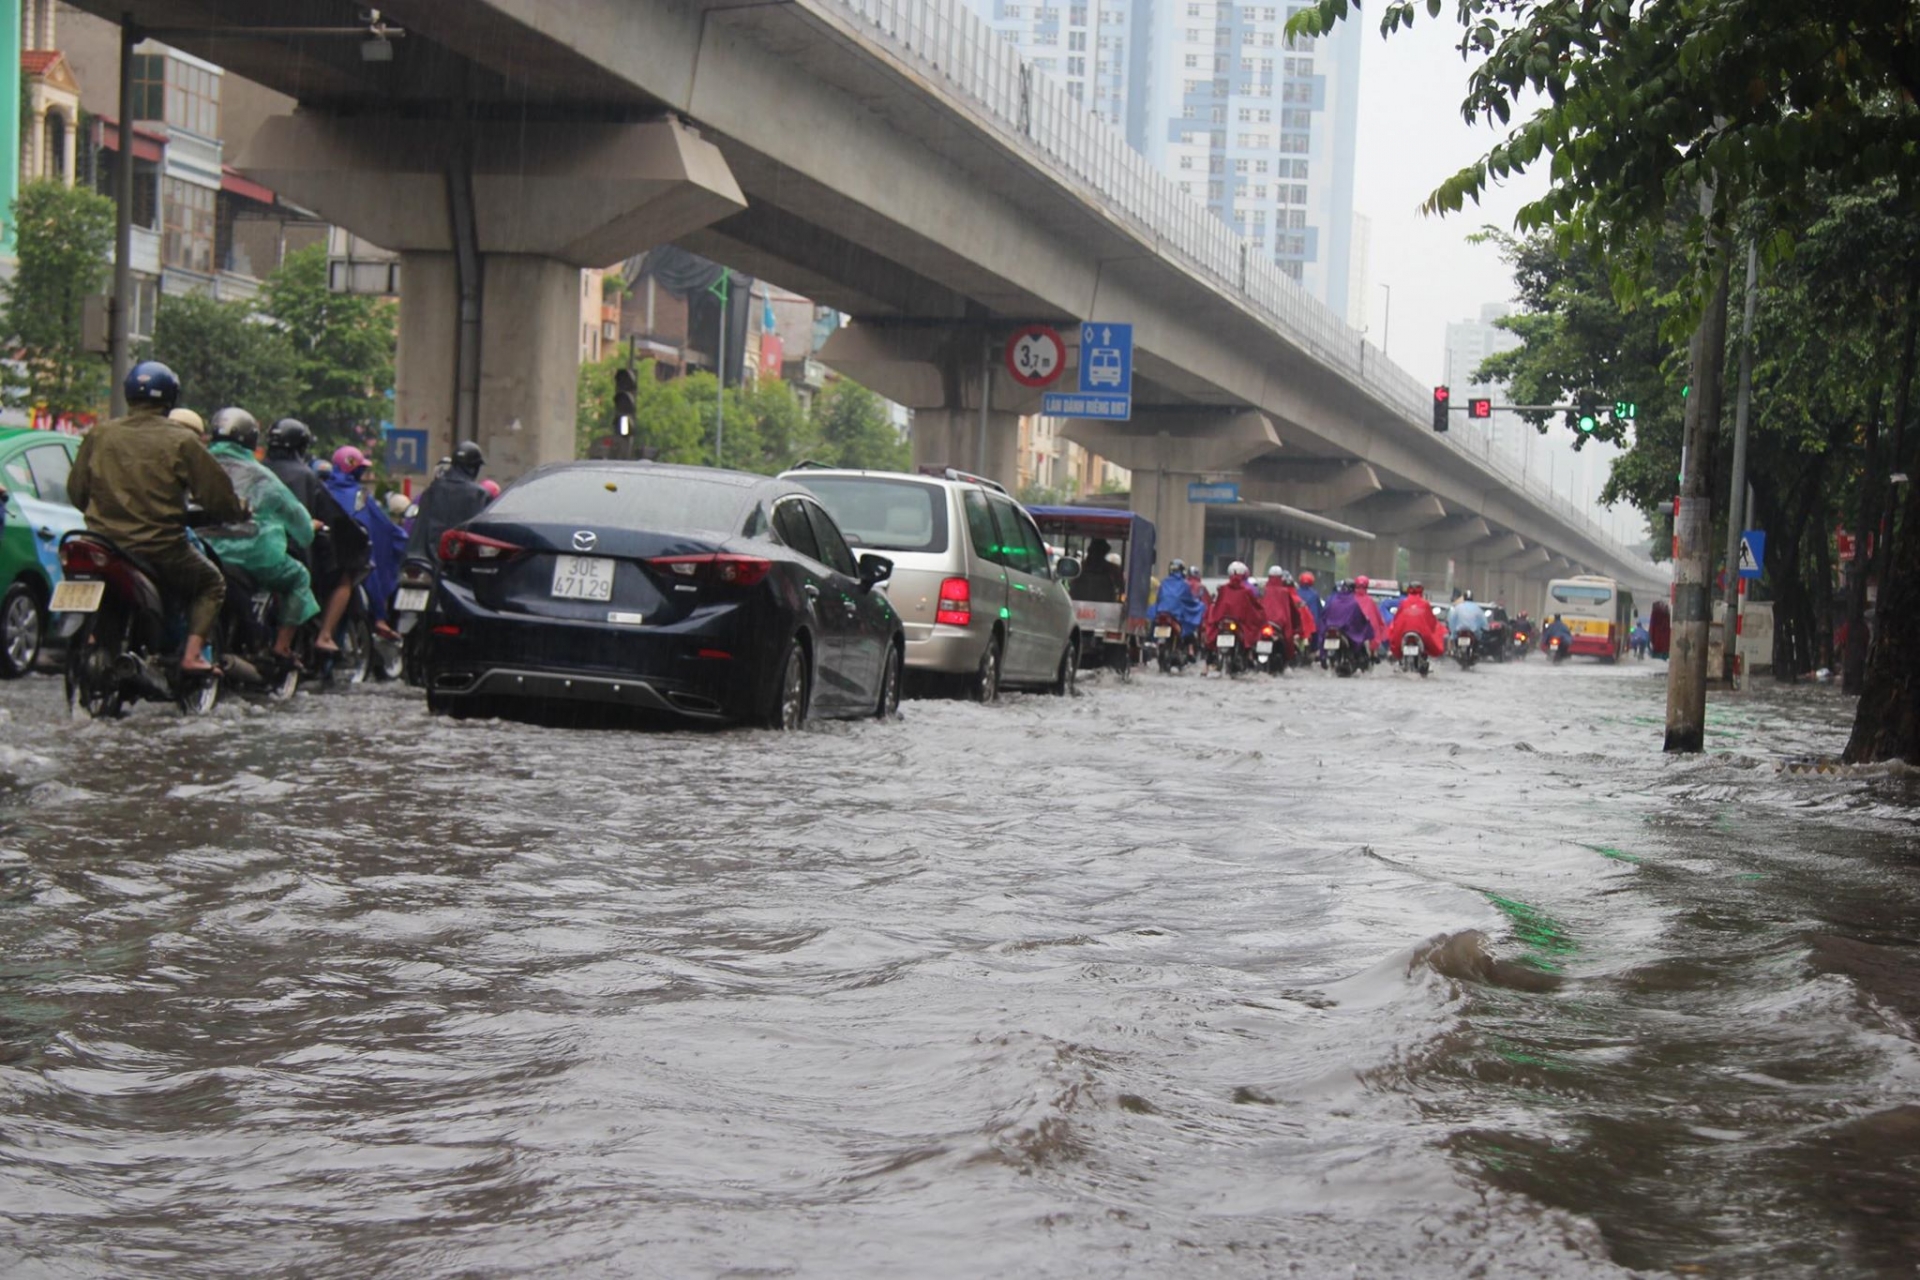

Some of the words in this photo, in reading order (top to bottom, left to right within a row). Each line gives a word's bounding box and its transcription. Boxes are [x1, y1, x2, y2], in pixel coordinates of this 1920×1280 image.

[1476, 400, 1489, 416] 12
[568, 556, 600, 577] 30E
[554, 576, 610, 598] 471.29
